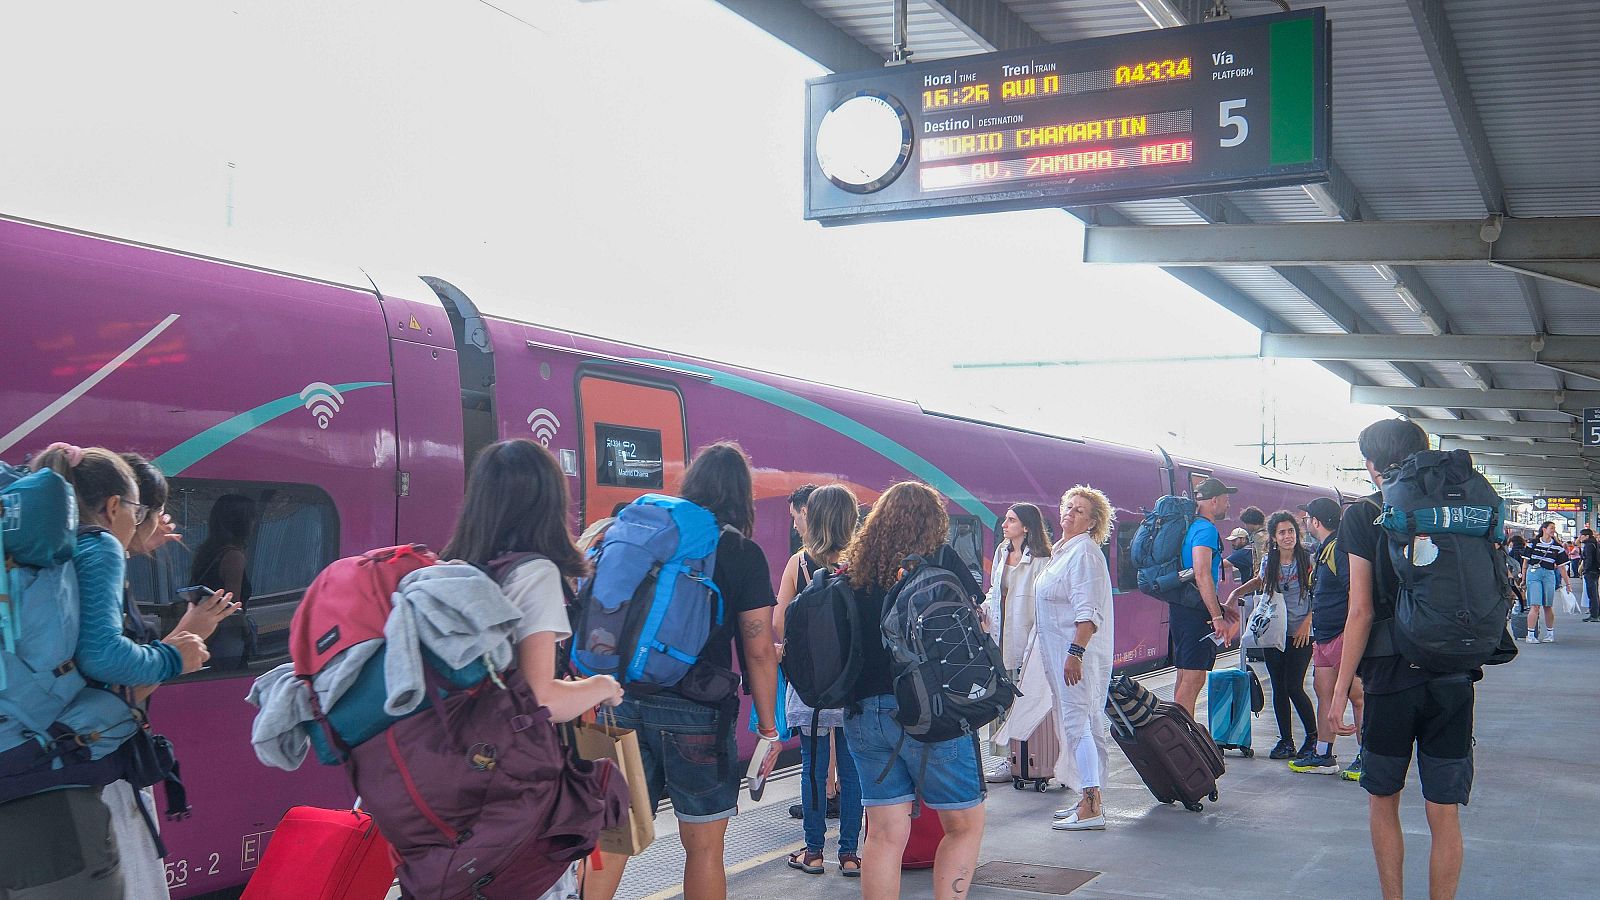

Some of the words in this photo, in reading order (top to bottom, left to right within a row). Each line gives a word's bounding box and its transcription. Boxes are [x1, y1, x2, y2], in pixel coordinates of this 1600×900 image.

[1211, 51, 1234, 66] Vía
[1002, 64, 1030, 77] Tren
[1034, 62, 1057, 74] TRAIN
[1212, 67, 1254, 81] PLATFORM
[924, 74, 952, 87] Hora
[959, 72, 977, 83] TIME
[922, 84, 990, 109] 16:26
[924, 119, 970, 133] Destino
[978, 114, 1024, 127] DESTINATION
[1219, 98, 1249, 148] 5
[1016, 116, 1147, 148] CHAMARTIN
[630, 443, 637, 458] 2
[244, 839, 256, 863] E
